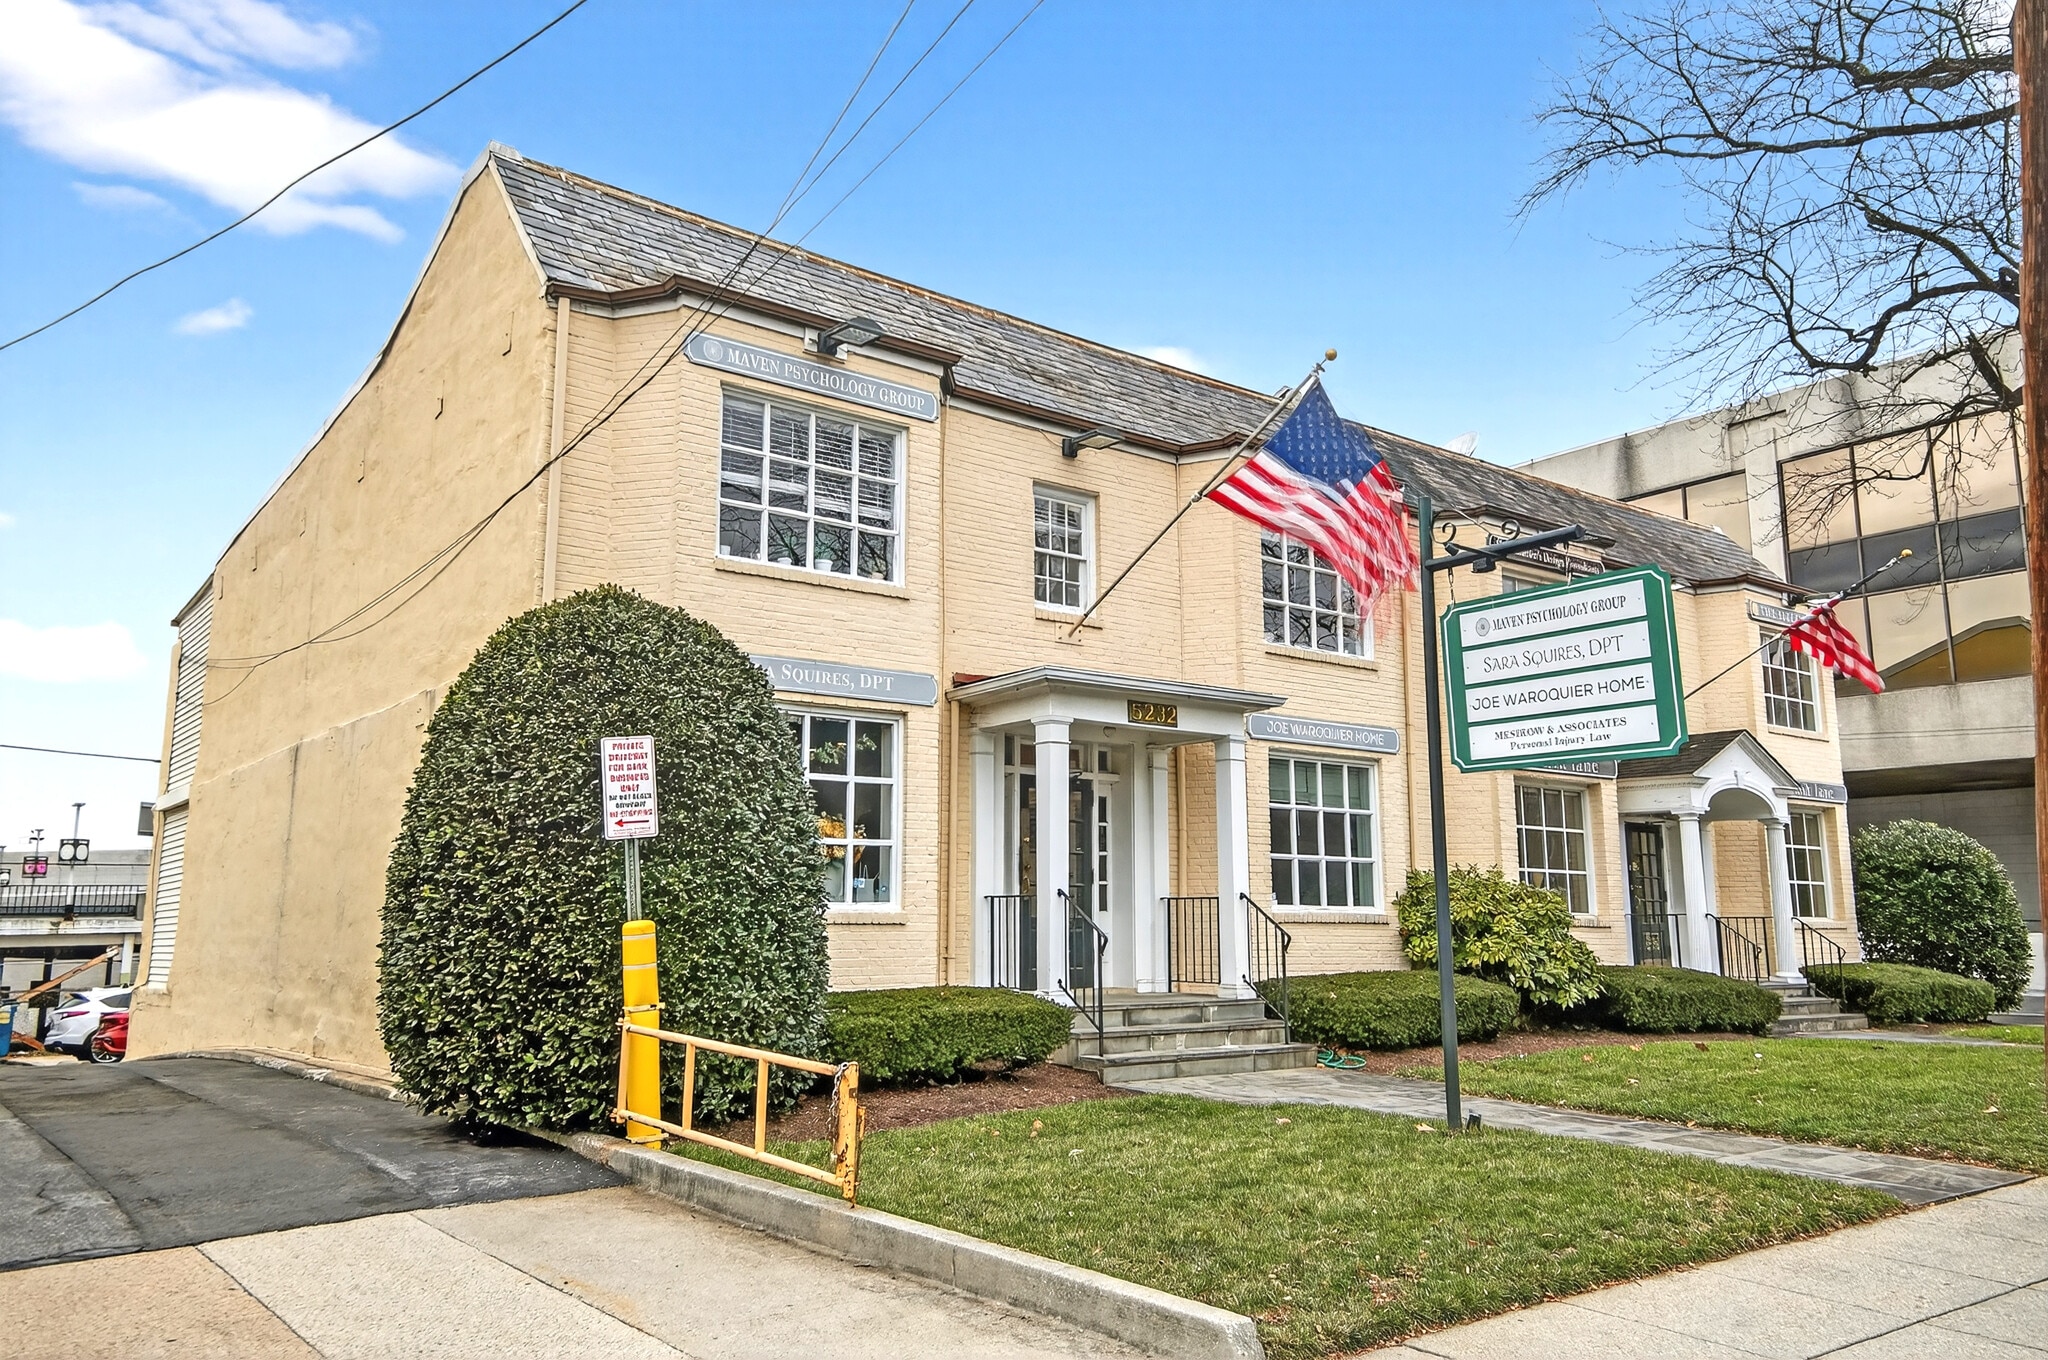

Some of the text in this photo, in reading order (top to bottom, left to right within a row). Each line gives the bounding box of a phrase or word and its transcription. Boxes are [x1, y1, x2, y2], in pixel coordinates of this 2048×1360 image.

[727, 348, 925, 411] MAVEN PSYCHOLOGY GROUP
[1492, 595, 1627, 631] MAVEN PSYCHOLOGY GROUP
[1484, 634, 1624, 673] SARA SQUIRES, DPT
[781, 664, 855, 691] SQUIRES,
[860, 673, 894, 692] DPT
[1472, 676, 1645, 711] JOE WAROQUIER HOME
[1131, 704, 1177, 725] 5232
[1266, 720, 1289, 735] JOE
[1546, 725, 1555, 735] &
[1557, 716, 1627, 733] ASSOCIATES
[1510, 733, 1612, 750] Personal Injury Law
